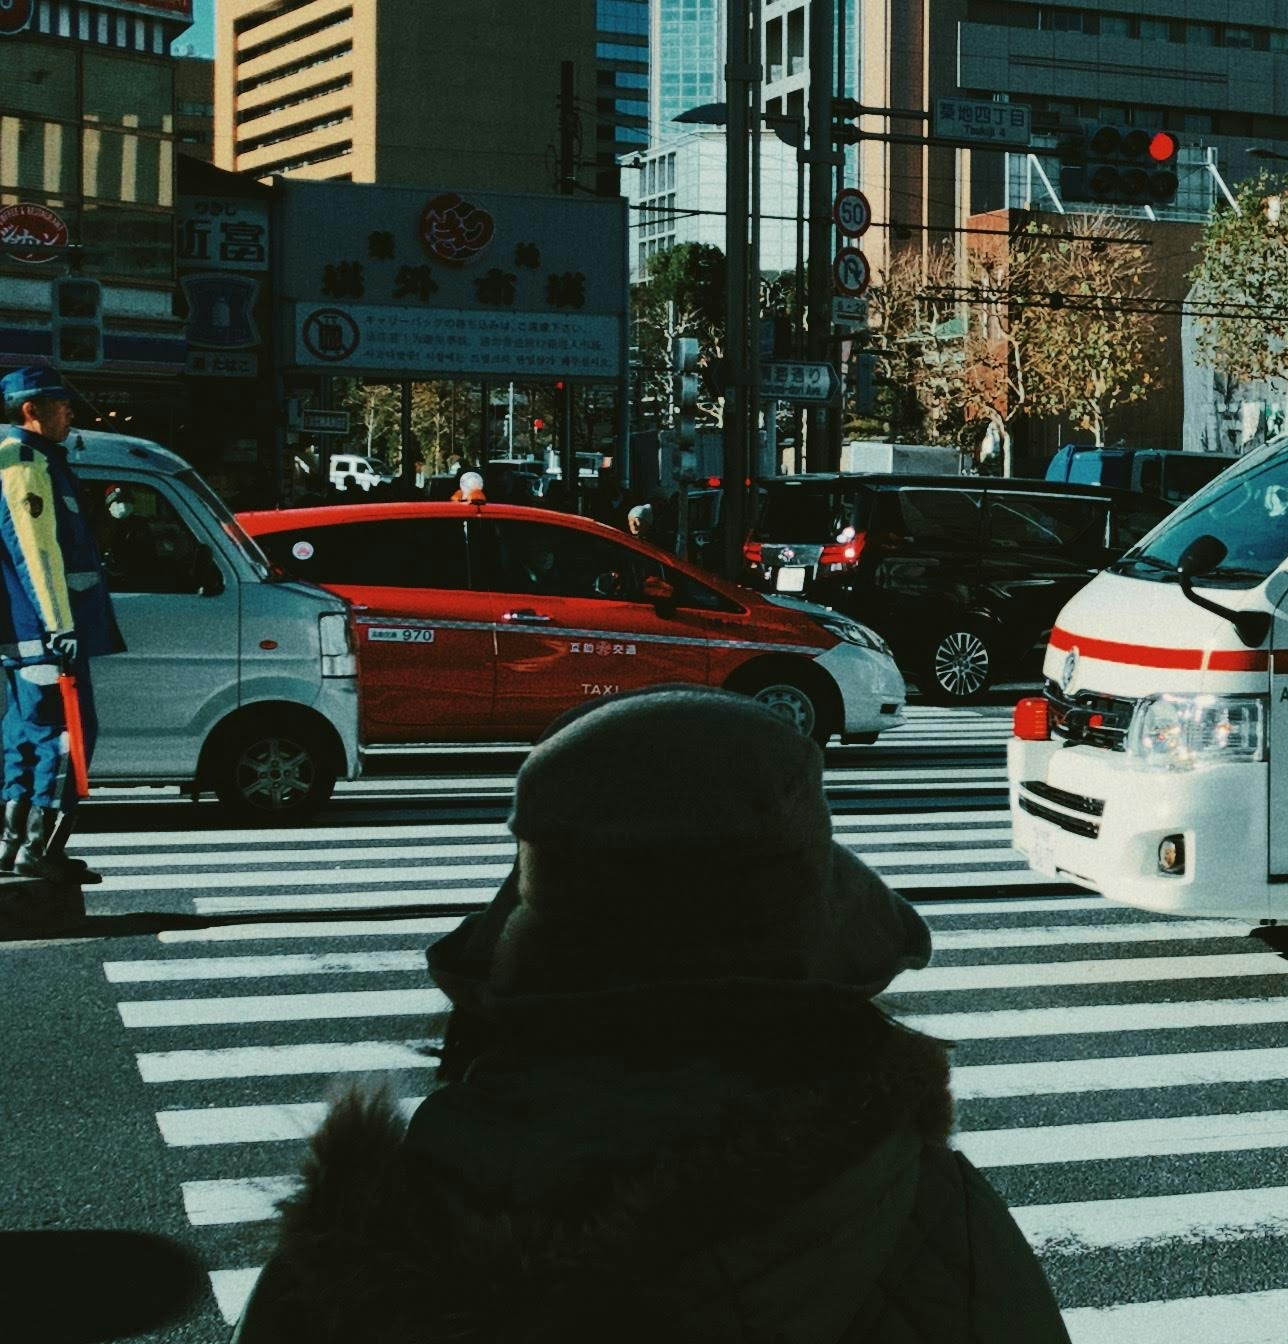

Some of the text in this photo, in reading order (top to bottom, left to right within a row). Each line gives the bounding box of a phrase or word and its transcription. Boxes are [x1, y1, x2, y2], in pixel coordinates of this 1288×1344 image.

[940, 103, 1024, 127] 築地四丁目
[963, 124, 995, 138] Tsukiji
[841, 202, 864, 225] 50
[402, 629, 432, 641] 970
[581, 683, 619, 696] TAXI
